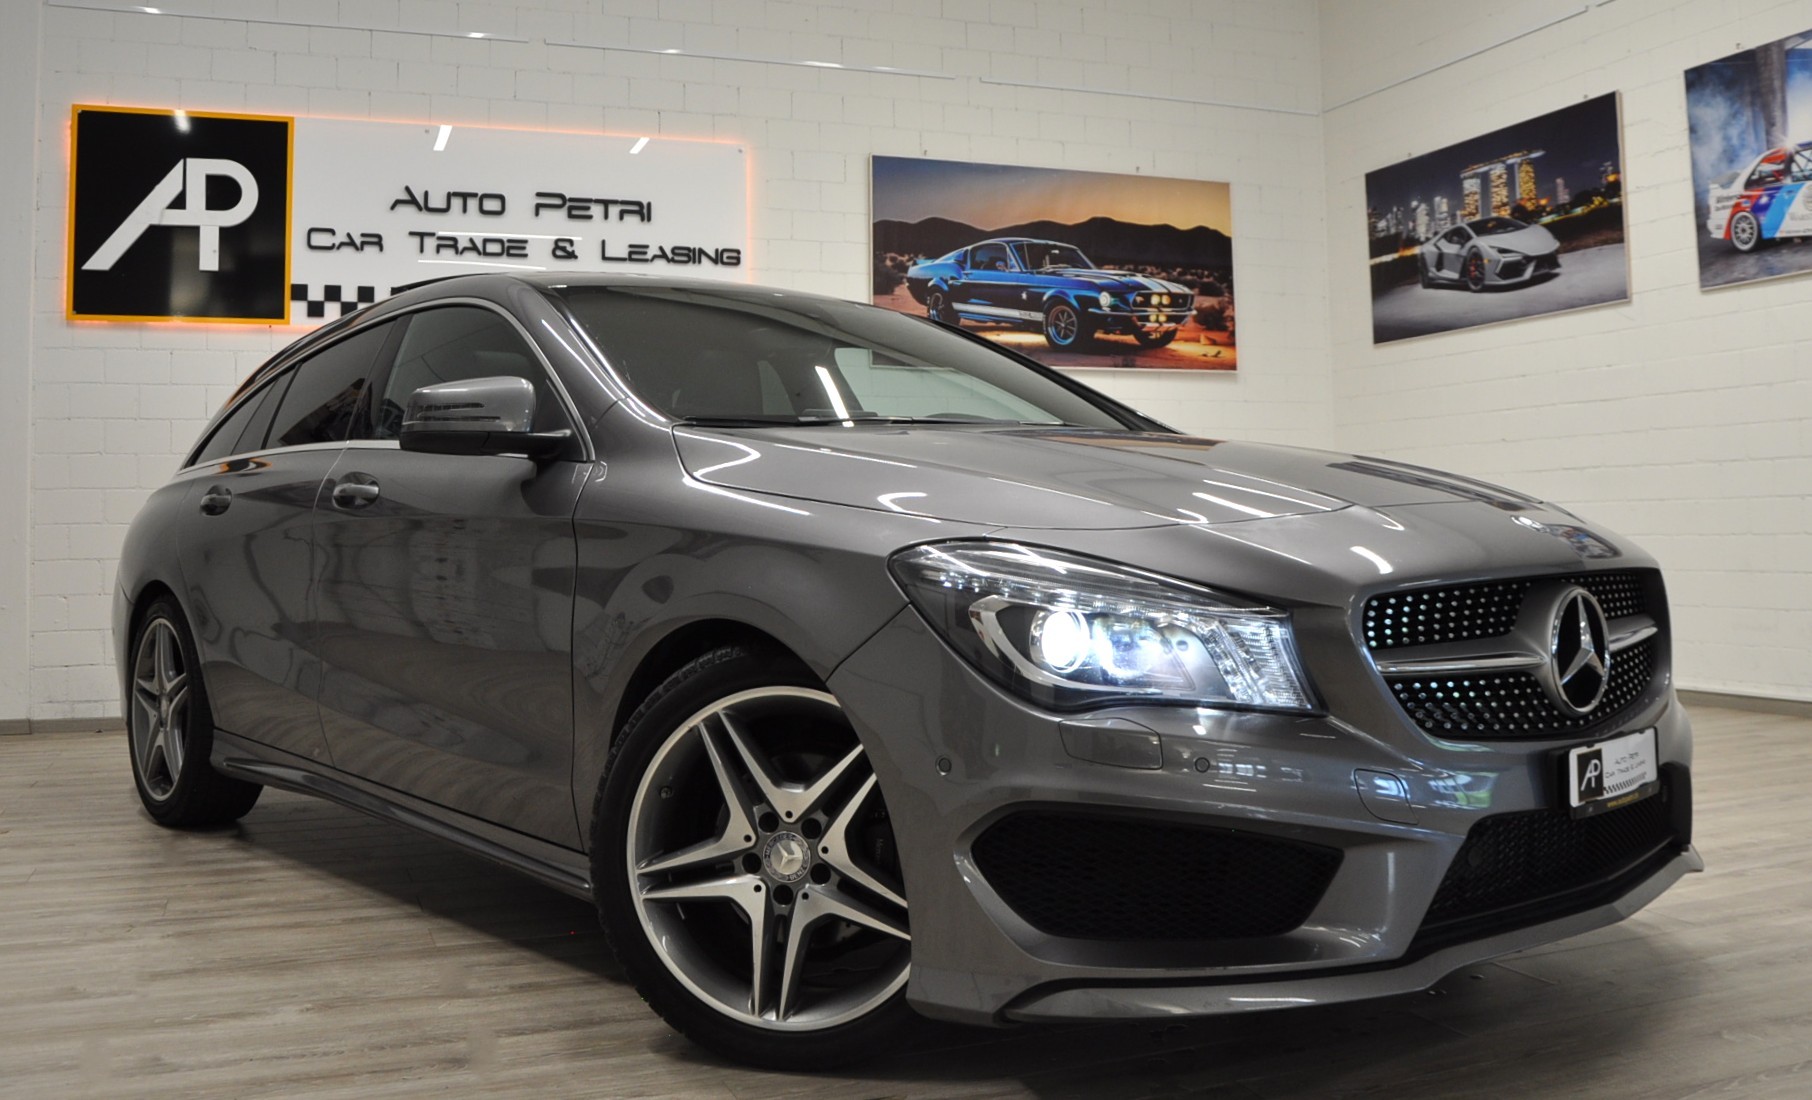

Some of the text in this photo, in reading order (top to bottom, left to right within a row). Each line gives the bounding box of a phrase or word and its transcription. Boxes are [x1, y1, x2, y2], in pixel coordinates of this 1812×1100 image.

[390, 185, 652, 223] AUTO PETRI
[306, 227, 741, 266] CAR TRADE & LEASING
